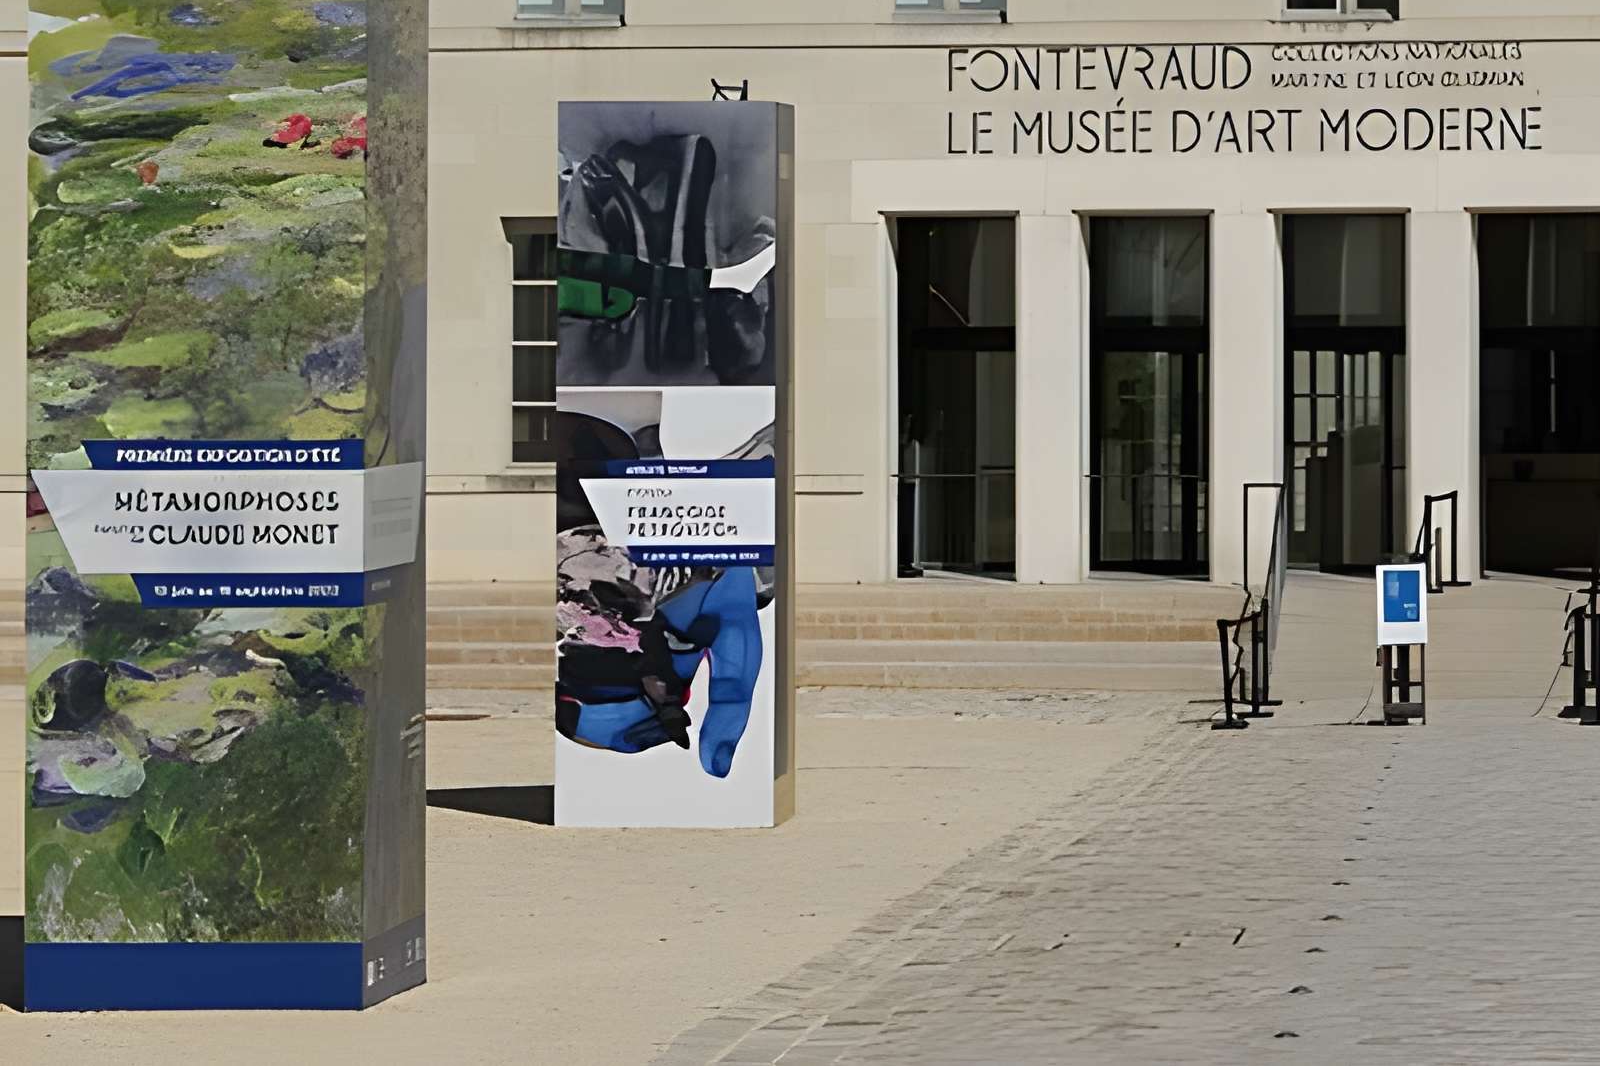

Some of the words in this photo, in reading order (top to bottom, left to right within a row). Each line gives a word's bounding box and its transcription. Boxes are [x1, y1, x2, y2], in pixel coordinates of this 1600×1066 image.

[948, 46, 1252, 92] FONTEVRAUD
[947, 111, 994, 155] LE
[1012, 97, 1153, 155] MUSÉE
[1172, 109, 1303, 154] D'ART
[1319, 106, 1543, 152] MODERNE
